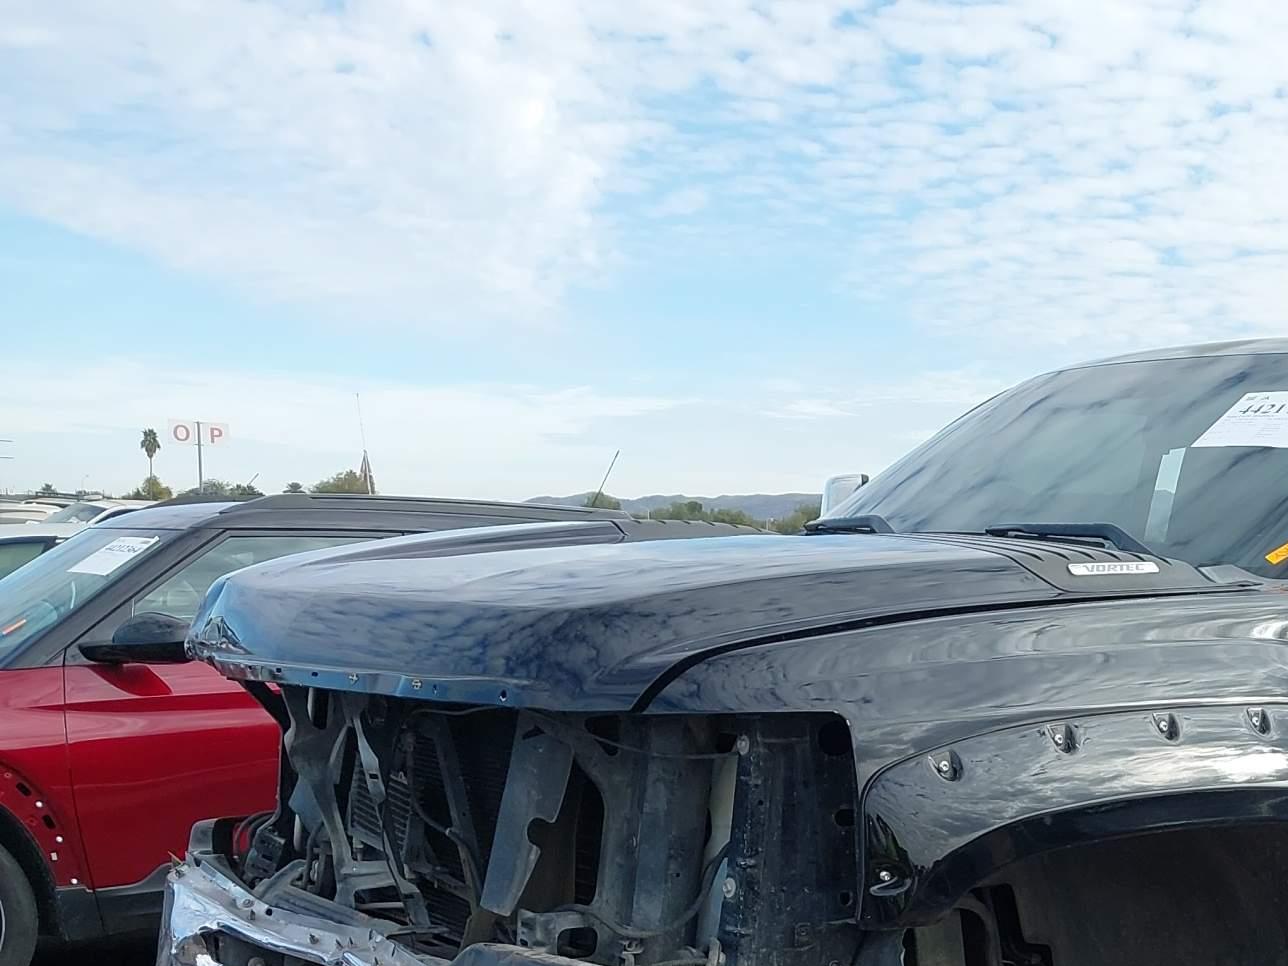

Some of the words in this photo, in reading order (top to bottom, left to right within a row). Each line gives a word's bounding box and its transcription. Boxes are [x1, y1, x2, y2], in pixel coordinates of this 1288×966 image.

[173, 424, 190, 442] O
[209, 427, 223, 443] P
[1082, 563, 1145, 572] VORTEC
